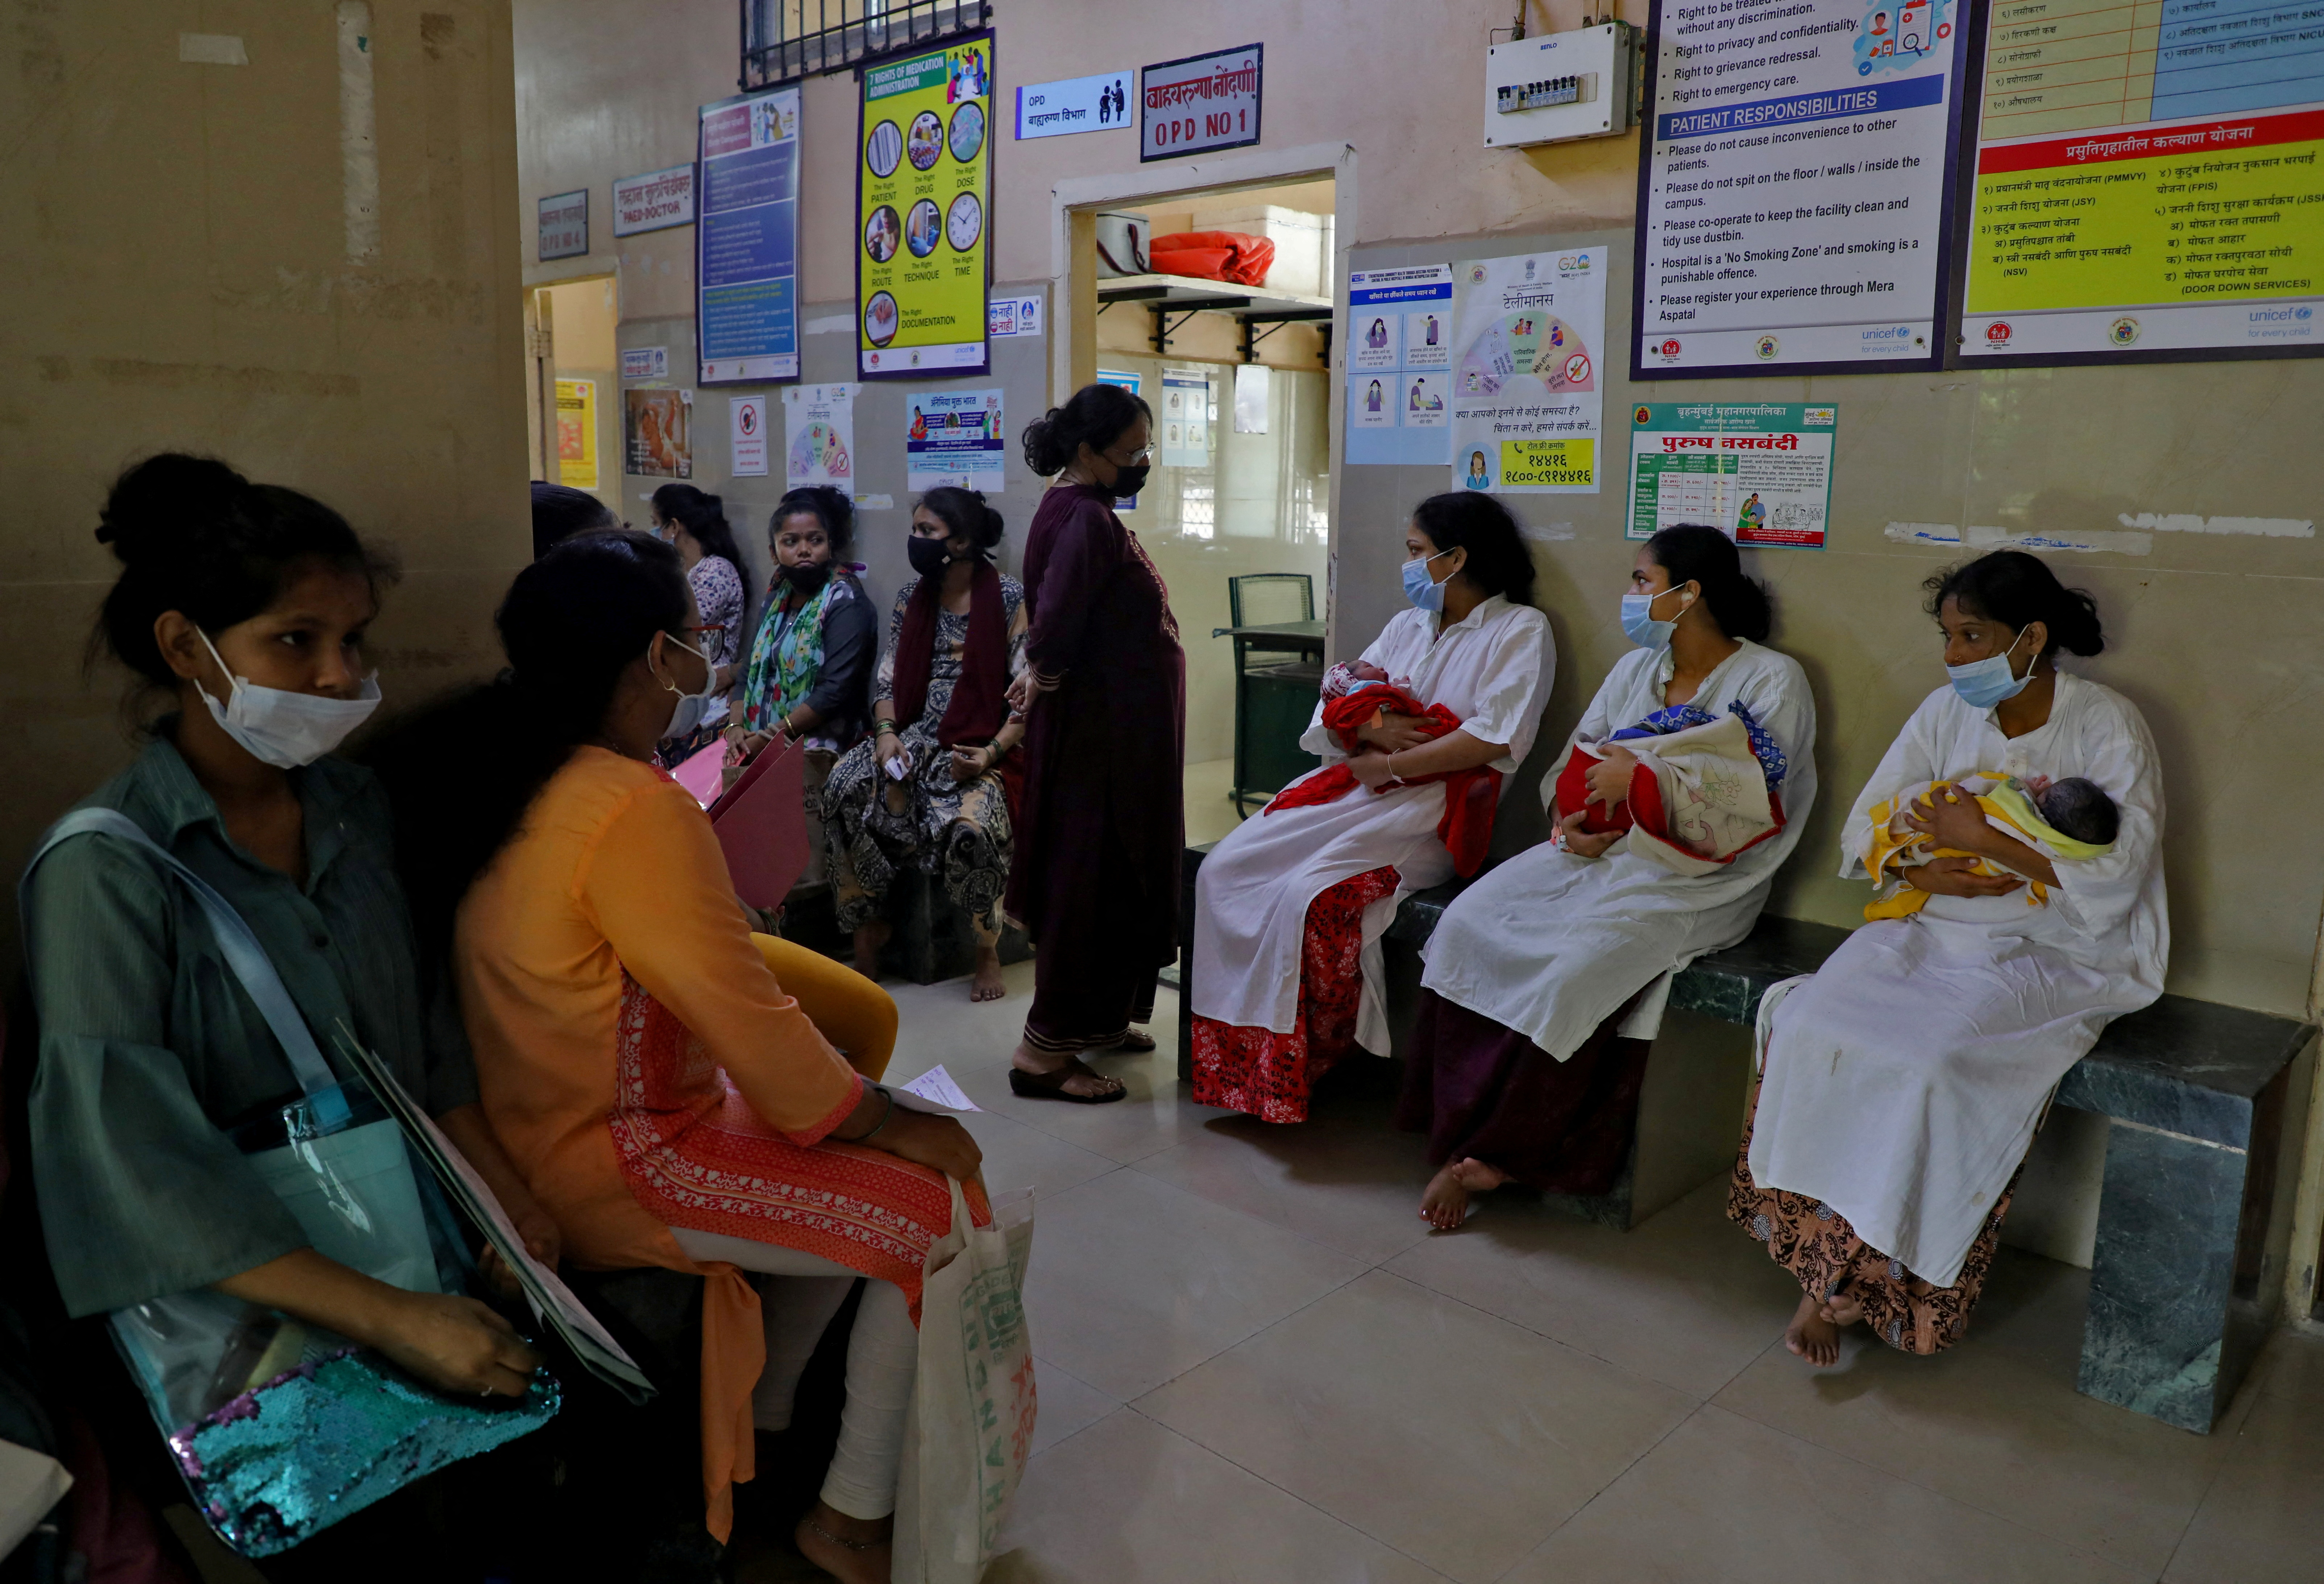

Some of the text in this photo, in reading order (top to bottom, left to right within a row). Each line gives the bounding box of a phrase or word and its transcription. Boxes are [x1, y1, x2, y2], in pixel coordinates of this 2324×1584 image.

[1677, 4, 1815, 35] without any discrimination.
[1676, 19, 1858, 58] Right to privacy and confidentiality.
[875, 69, 895, 84] RIGHTS
[897, 67, 904, 78] OF
[906, 56, 943, 75] MEDICATION
[1674, 47, 1820, 80] Right to grievance redressal.
[870, 76, 920, 98] ADMINISTRATION
[1673, 76, 1798, 102] Right to emergency care.
[1029, 96, 1045, 106] OPD
[1062, 108, 1086, 121] विभाग
[1670, 91, 1877, 133] PATIENT RESPONSIBILITIES
[1156, 108, 1246, 146] OPD NO 1
[1669, 119, 1897, 156] Please do not cause inconvenience to other
[2066, 127, 2255, 160] प्रसुतिगृहातील कल्याण योजना
[1668, 159, 1709, 174] patients.
[957, 177, 974, 187] DOSE
[1667, 156, 1920, 194] Please do not spit on the floor / walls / inside the
[916, 185, 933, 195] DRUG
[1984, 186, 1993, 195] १)
[1996, 180, 2032, 193] प्रधानमंत्री
[2105, 172, 2146, 184] (PMMVY)
[2156, 182, 2217, 194] योजना (FPIS)
[871, 192, 897, 203] PATIENT
[1665, 198, 1705, 210] campus.
[1983, 198, 2095, 214] २) जननी शिशु योजना (JSY)
[1664, 197, 1908, 231] Please co-operate to keep the facility clean and
[1981, 217, 2080, 235] ३) कुटुंब कल्याण योजना
[1663, 230, 1743, 248] tidy use dustbin.
[1663, 255, 1701, 269] Hospital
[1705, 255, 1712, 265] is
[1725, 252, 1740, 263] 'No
[1744, 249, 1788, 261] Smoking
[1792, 245, 1821, 257] Zone'
[1824, 243, 1844, 255] and
[1848, 240, 1895, 253] smoking
[1899, 238, 1908, 249] is
[1912, 240, 1918, 248] a
[904, 270, 939, 282] TECHNIQUE
[955, 267, 970, 276] TIME
[1661, 268, 1756, 286] punishable offence.
[2004, 268, 2027, 277] (NSV)
[872, 277, 892, 287] ROUTE
[2182, 280, 2310, 295] (DOOR DOWN SERVICES)
[1661, 281, 1894, 305] Please register your experience through Mera
[1503, 293, 1554, 309] टेलीमानस
[902, 316, 955, 328] DOCUMENTATION
[1660, 309, 1695, 322] Aspatal
[1862, 327, 1895, 339] unicef
[1471, 407, 1497, 418] आपको
[1498, 406, 1515, 419] इनमें
[1516, 406, 1523, 416] से
[1525, 406, 1540, 417] कोई
[1569, 404, 1580, 415] है?
[1677, 404, 1786, 419] बृहन्मुंबई महानगरपालिका
[1494, 423, 1511, 433] चिंता
[1521, 422, 1534, 433] करें,
[1537, 421, 1555, 432] हमसे
[1556, 421, 1576, 431] संपर्क
[1548, 440, 1565, 448] क्रमांक
[1662, 434, 1799, 452] पुरुष नसबंदी
[1529, 455, 1567, 467] १४४१६
[1506, 470, 1590, 483] १८००-८९१४४१६
